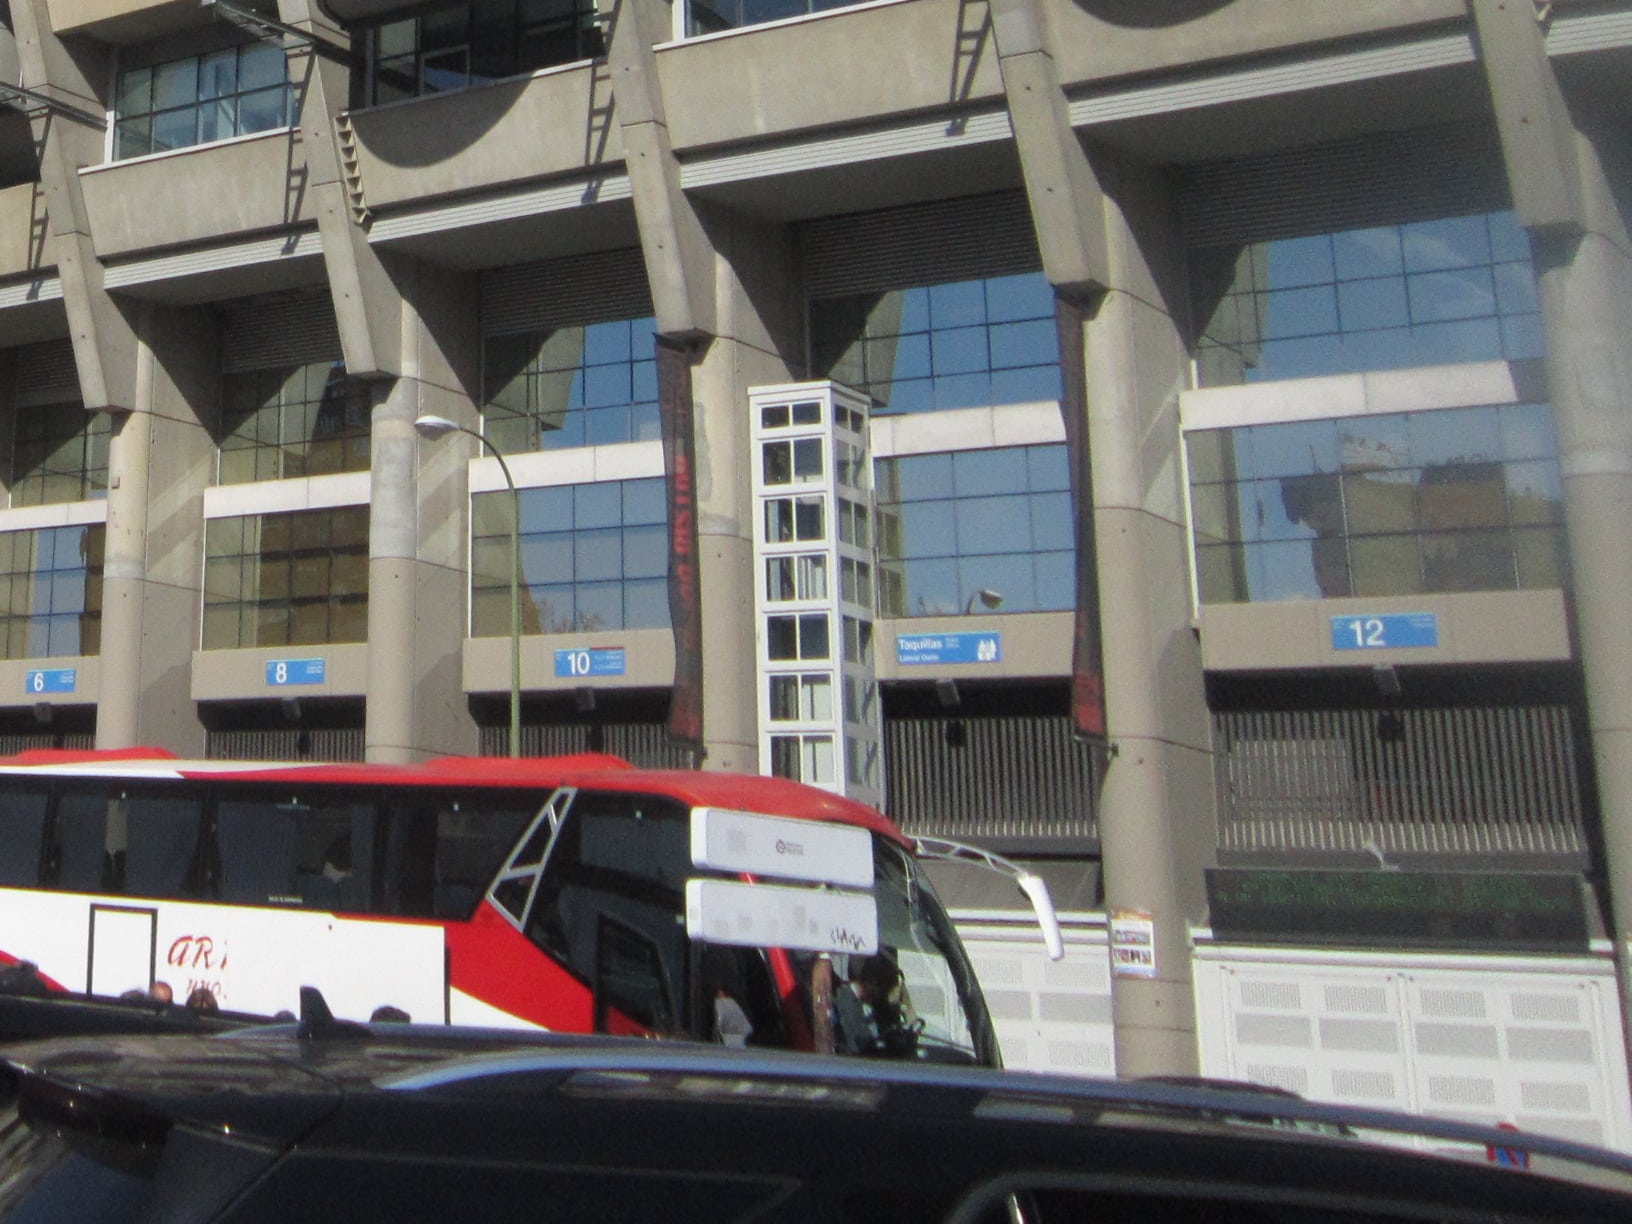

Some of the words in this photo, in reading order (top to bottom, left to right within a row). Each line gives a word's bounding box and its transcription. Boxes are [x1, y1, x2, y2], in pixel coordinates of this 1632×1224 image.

[1349, 619, 1386, 647] 12
[898, 638, 943, 651] Taquillas
[276, 662, 287, 683] 8
[567, 652, 590, 675] 10
[33, 672, 43, 692] 6
